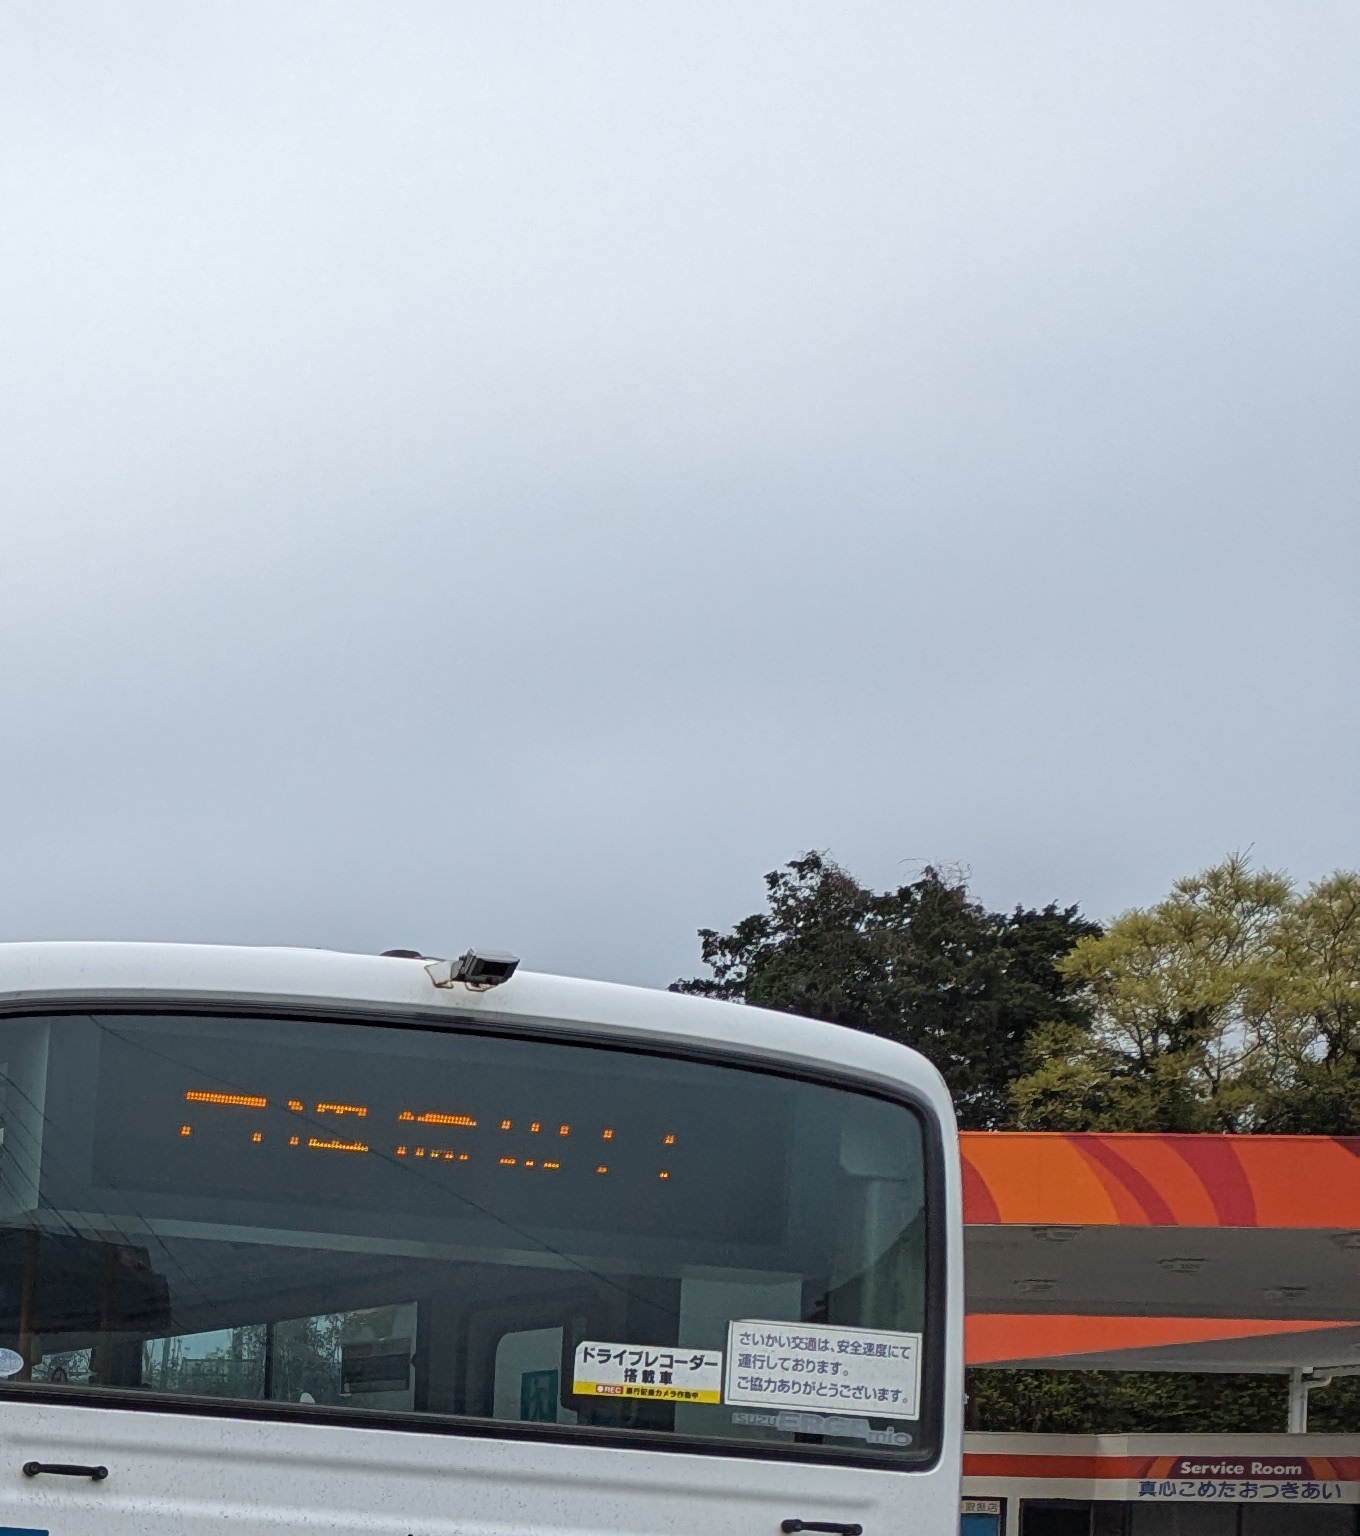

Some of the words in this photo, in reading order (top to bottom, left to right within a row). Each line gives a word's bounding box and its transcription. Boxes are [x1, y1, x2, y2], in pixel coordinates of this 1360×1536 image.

[739, 1331, 911, 1359] さいかい交通は、安全速度にて
[582, 1346, 718, 1371] ドライブレコーダー
[737, 1353, 849, 1377] 運行しております。
[623, 1367, 674, 1385] 搭載車
[604, 1386, 622, 1394] REC
[736, 1376, 909, 1404] ご協力ありがとうございます。
[1180, 1461, 1244, 1475] Service
[1250, 1461, 1302, 1475] Room
[1138, 1480, 1342, 1500] 真心こめたおつきあい
